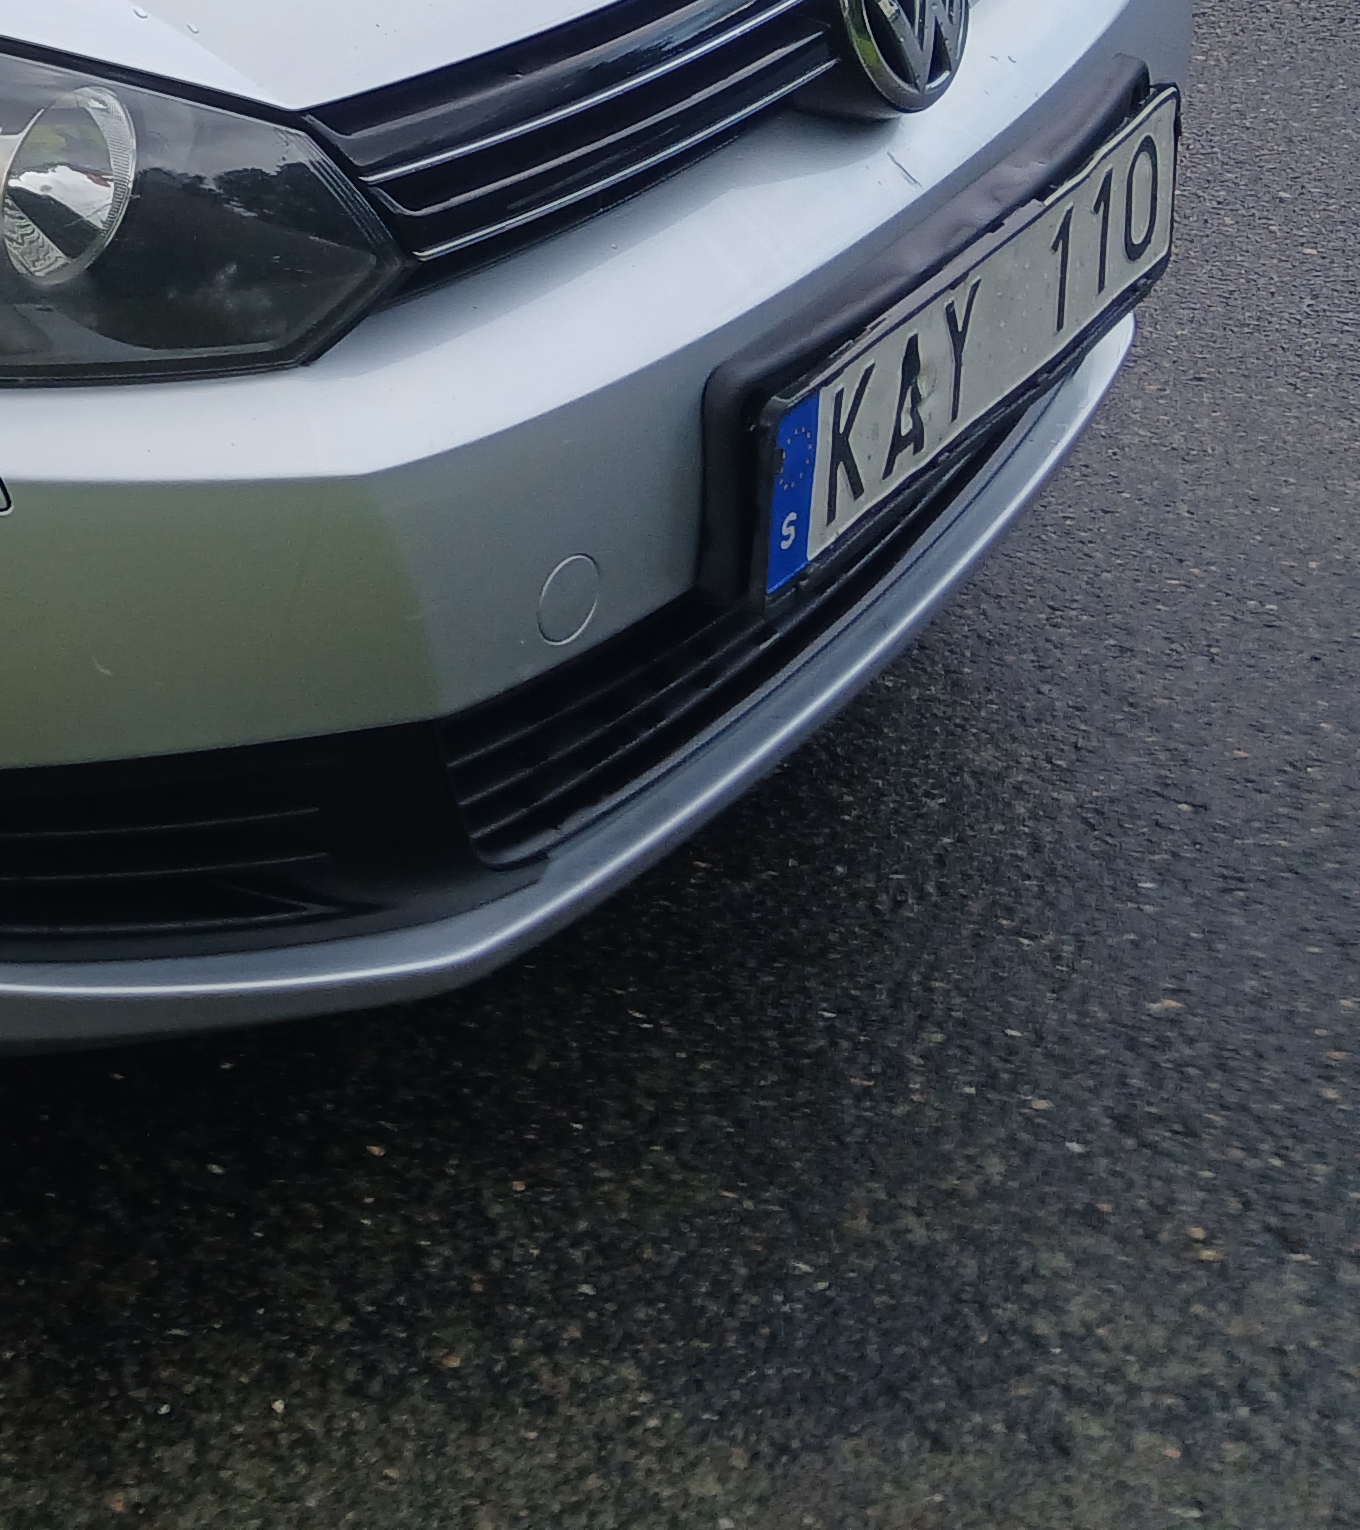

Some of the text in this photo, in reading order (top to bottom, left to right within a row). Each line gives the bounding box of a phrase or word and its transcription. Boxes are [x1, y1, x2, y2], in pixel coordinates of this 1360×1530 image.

[826, 134, 1158, 526] KAY 110
[780, 512, 797, 549] S
